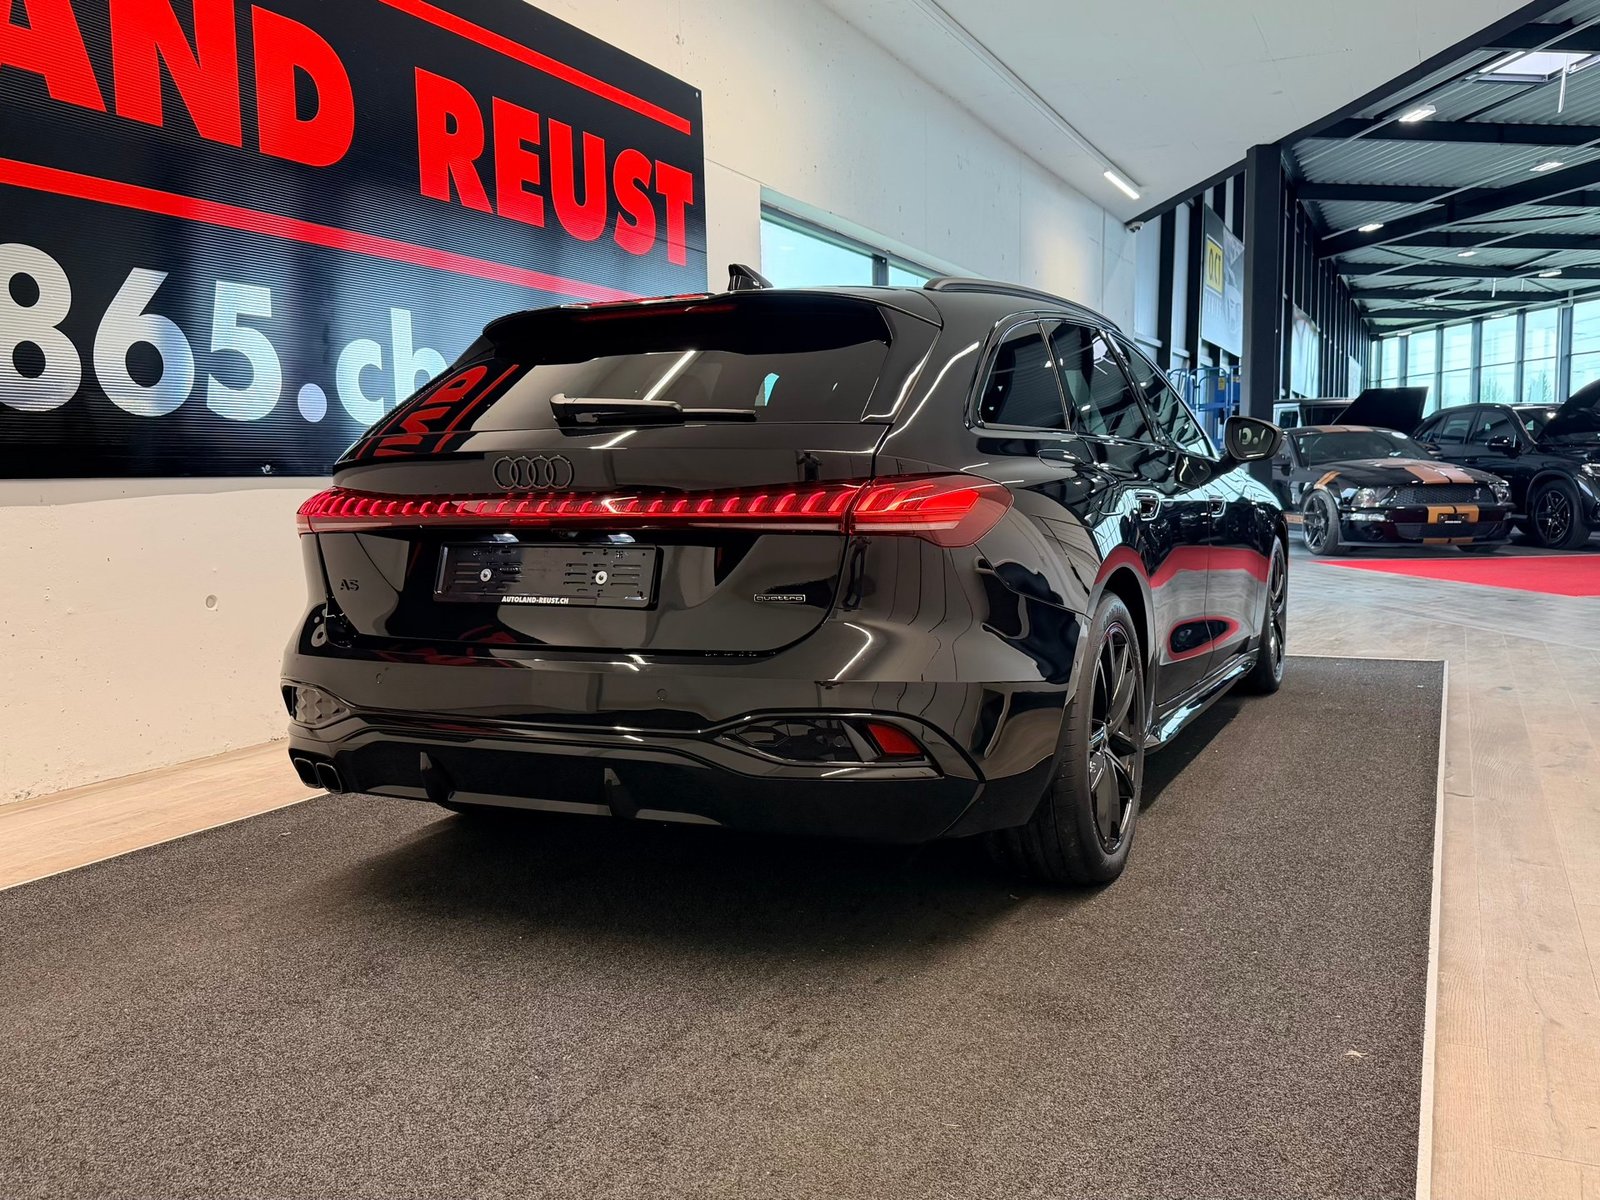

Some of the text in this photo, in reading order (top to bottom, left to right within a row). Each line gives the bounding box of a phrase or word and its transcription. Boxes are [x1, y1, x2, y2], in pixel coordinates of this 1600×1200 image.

[414, 66, 694, 266] REUST
[339, 578, 360, 592] A5
[501, 595, 569, 605] AUTOLAND-REUST.CH
